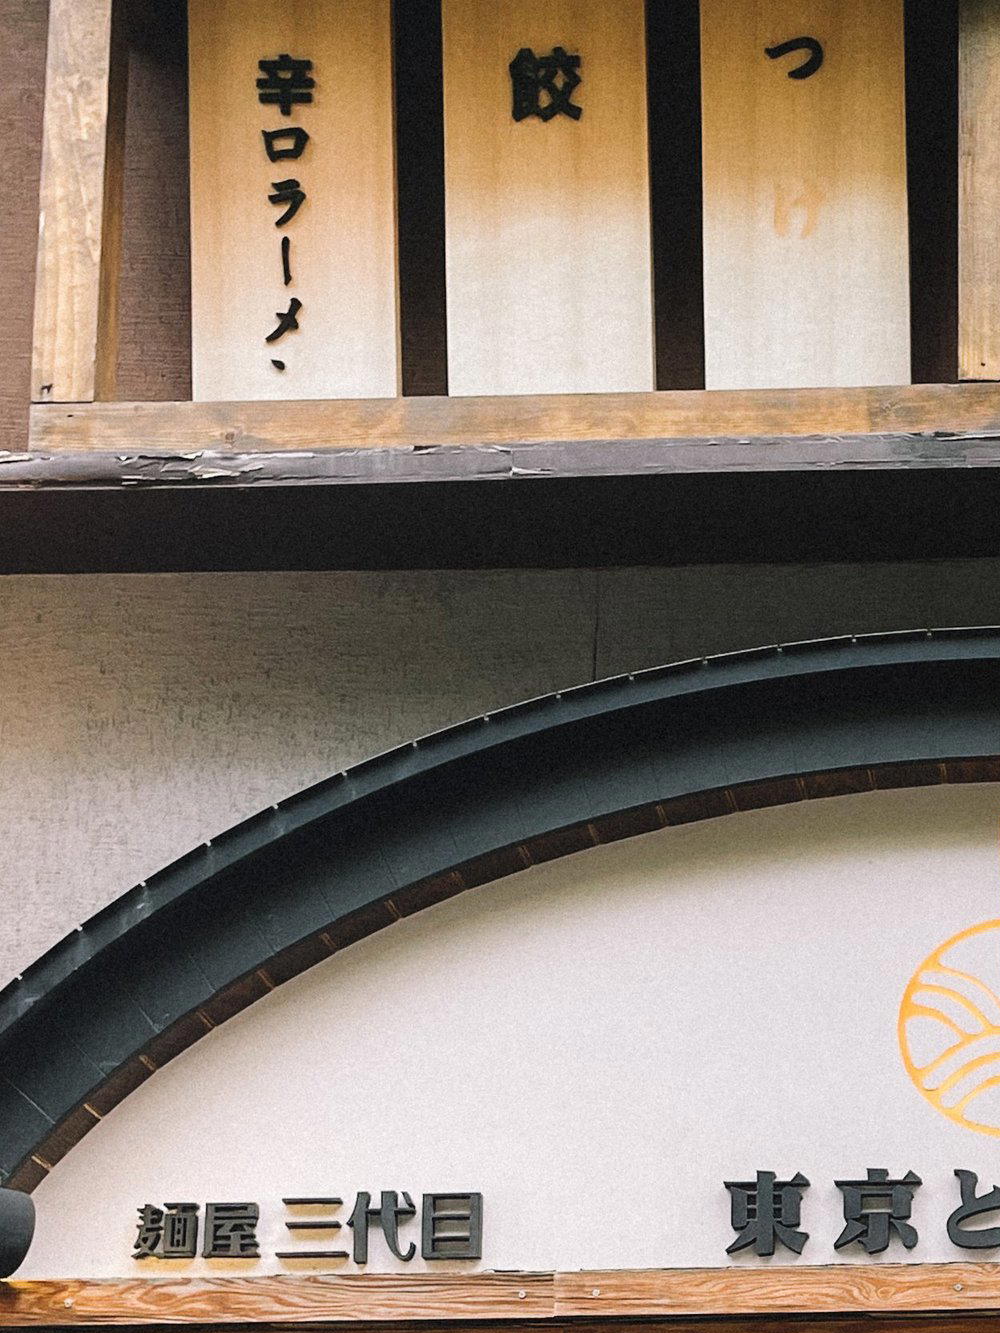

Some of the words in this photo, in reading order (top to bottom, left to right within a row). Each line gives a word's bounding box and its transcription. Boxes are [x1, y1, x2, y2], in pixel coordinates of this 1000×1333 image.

[256, 54, 315, 371] 辛口ラーメ
